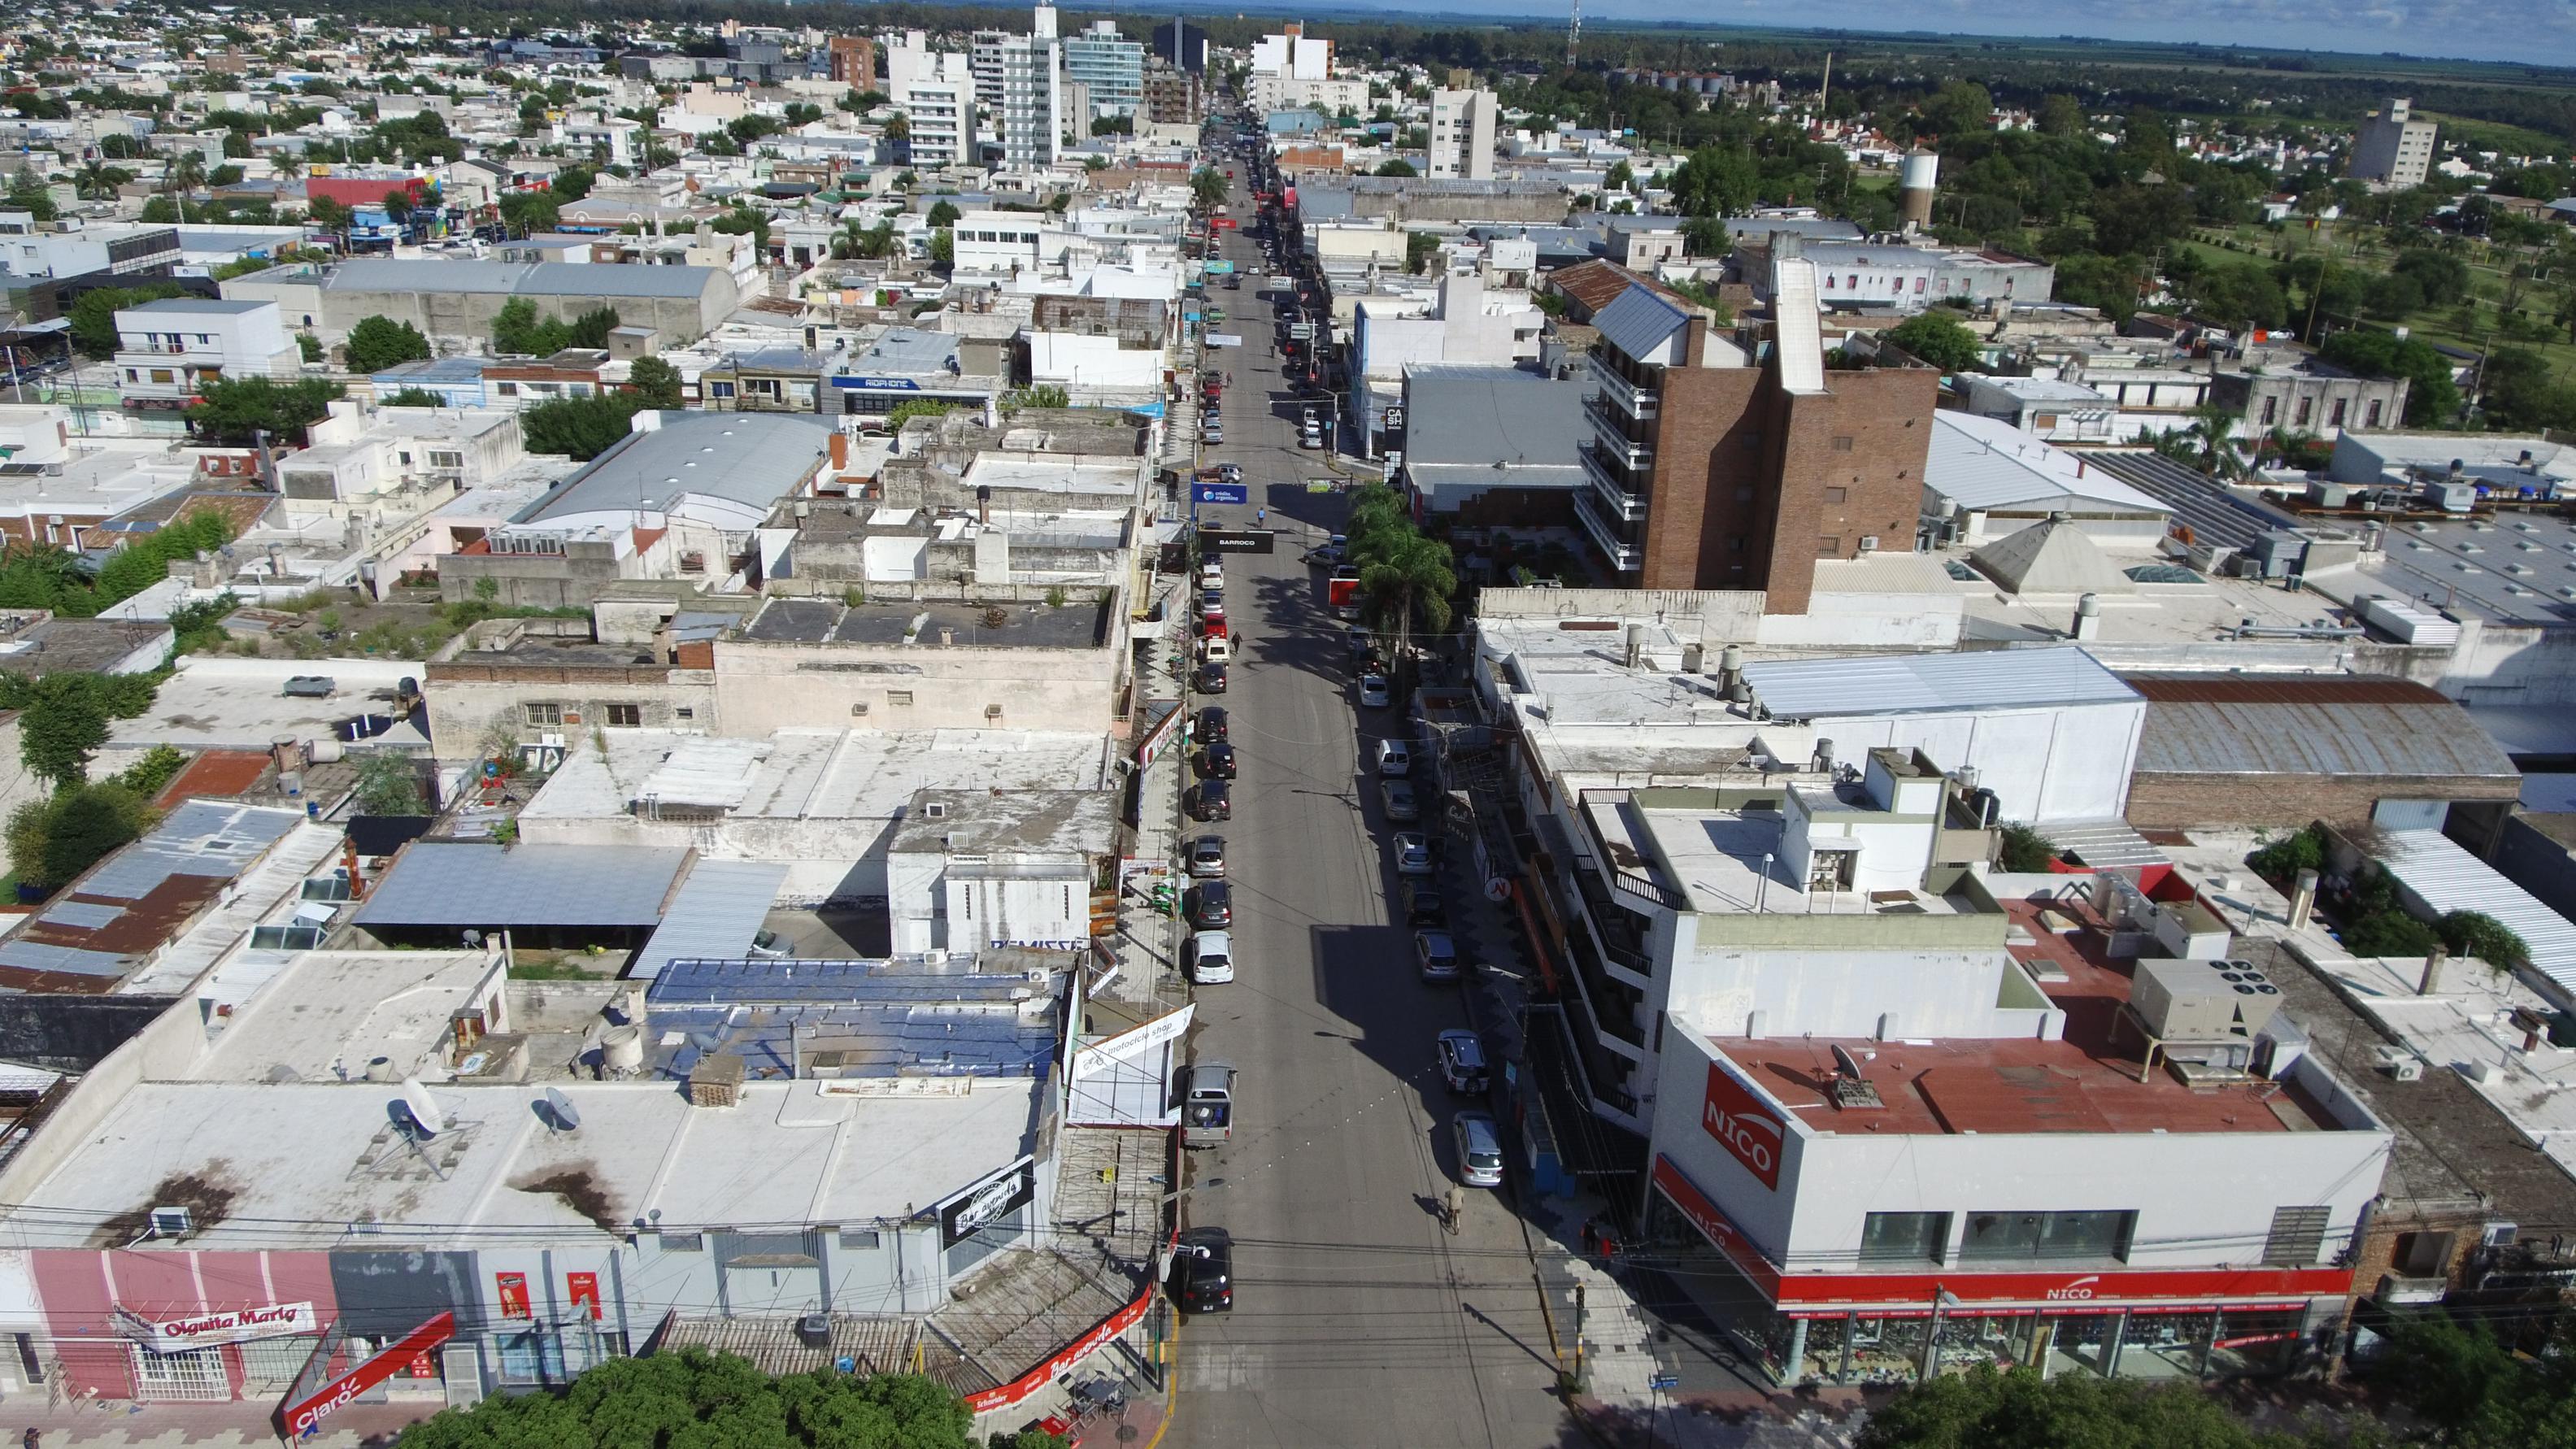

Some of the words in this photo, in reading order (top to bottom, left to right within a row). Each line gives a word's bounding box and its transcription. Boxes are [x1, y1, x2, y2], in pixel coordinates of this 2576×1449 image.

[1151, 1021, 1173, 1037] shop
[1708, 1100, 1771, 1172] NICO
[959, 1210, 978, 1229] Bar
[981, 1181, 1017, 1214] avenida
[1696, 1212, 1725, 1247] NICO
[2046, 1288, 2092, 1300] NICO
[164, 1316, 233, 1338] Olguita
[1051, 1357, 1071, 1380] Bar
[1073, 1325, 1112, 1361] avenida
[297, 1389, 352, 1429] Claro
